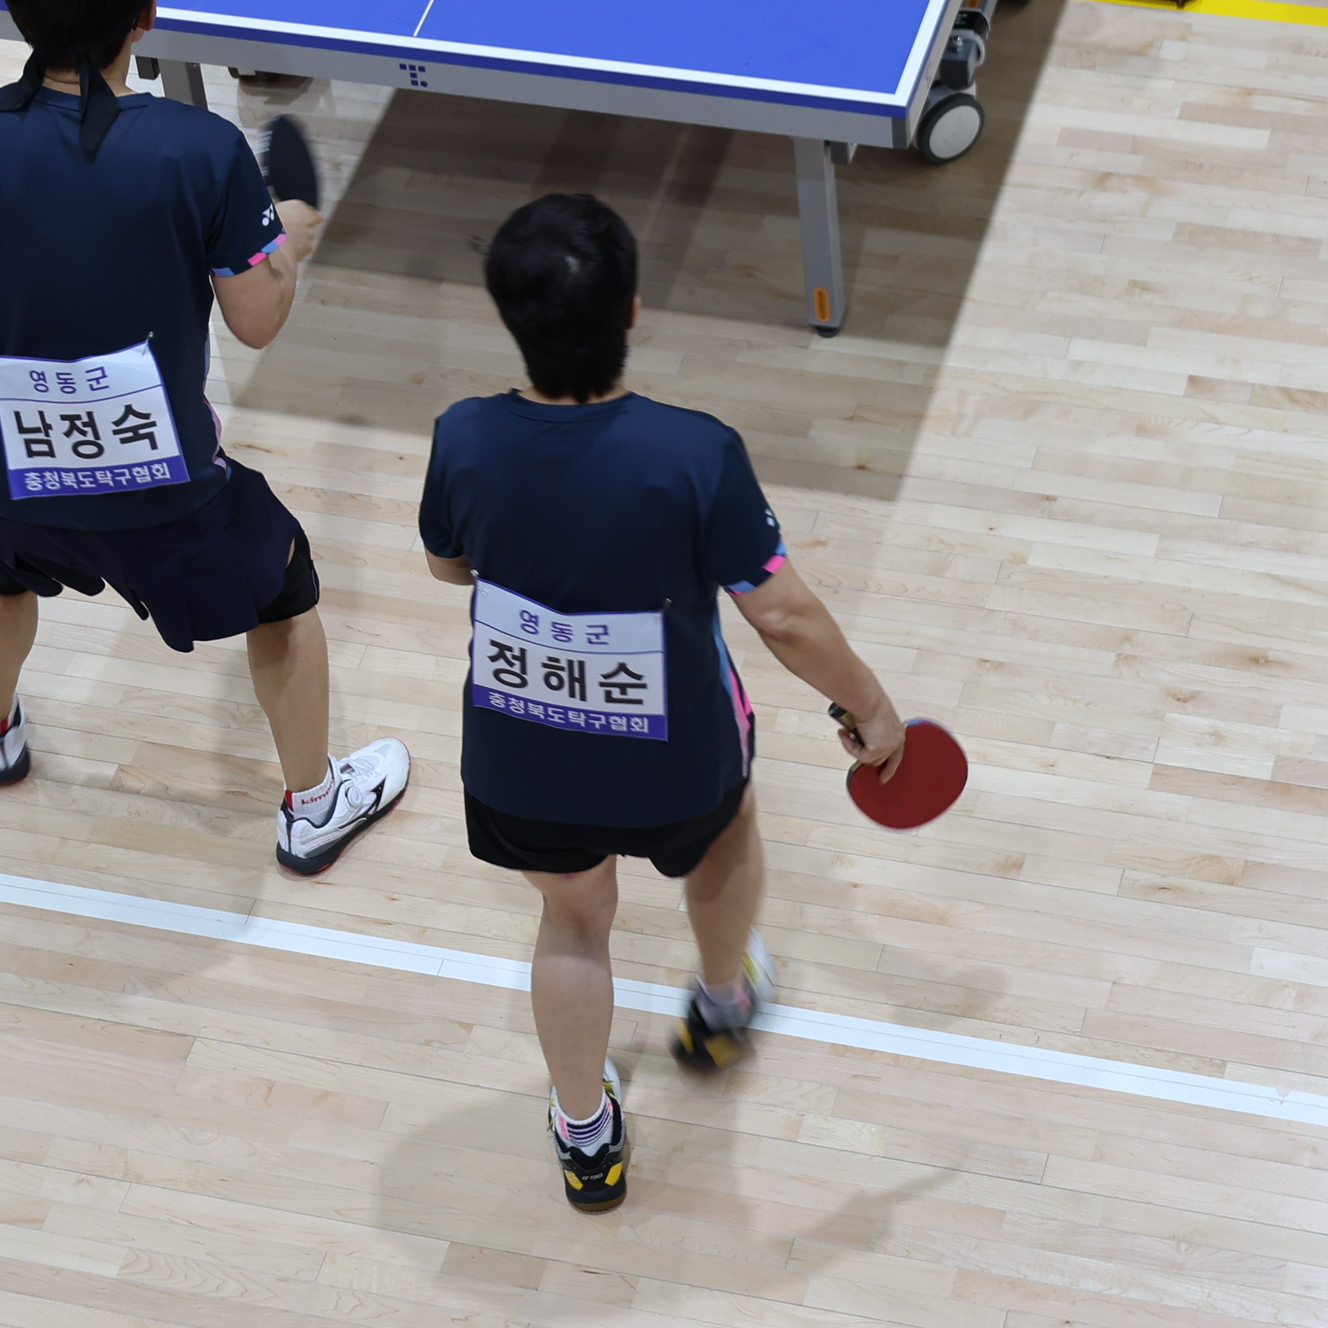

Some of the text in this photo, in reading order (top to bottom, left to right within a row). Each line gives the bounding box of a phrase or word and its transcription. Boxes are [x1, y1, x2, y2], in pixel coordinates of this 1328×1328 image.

[29, 366, 110, 395] 영동군
[13, 404, 159, 459] 남정숙
[24, 462, 171, 492] 충청북도탁구협회
[520, 609, 610, 645] 영동군
[487, 639, 647, 705] 정해순
[489, 691, 649, 734] 충청북도탁구협회
